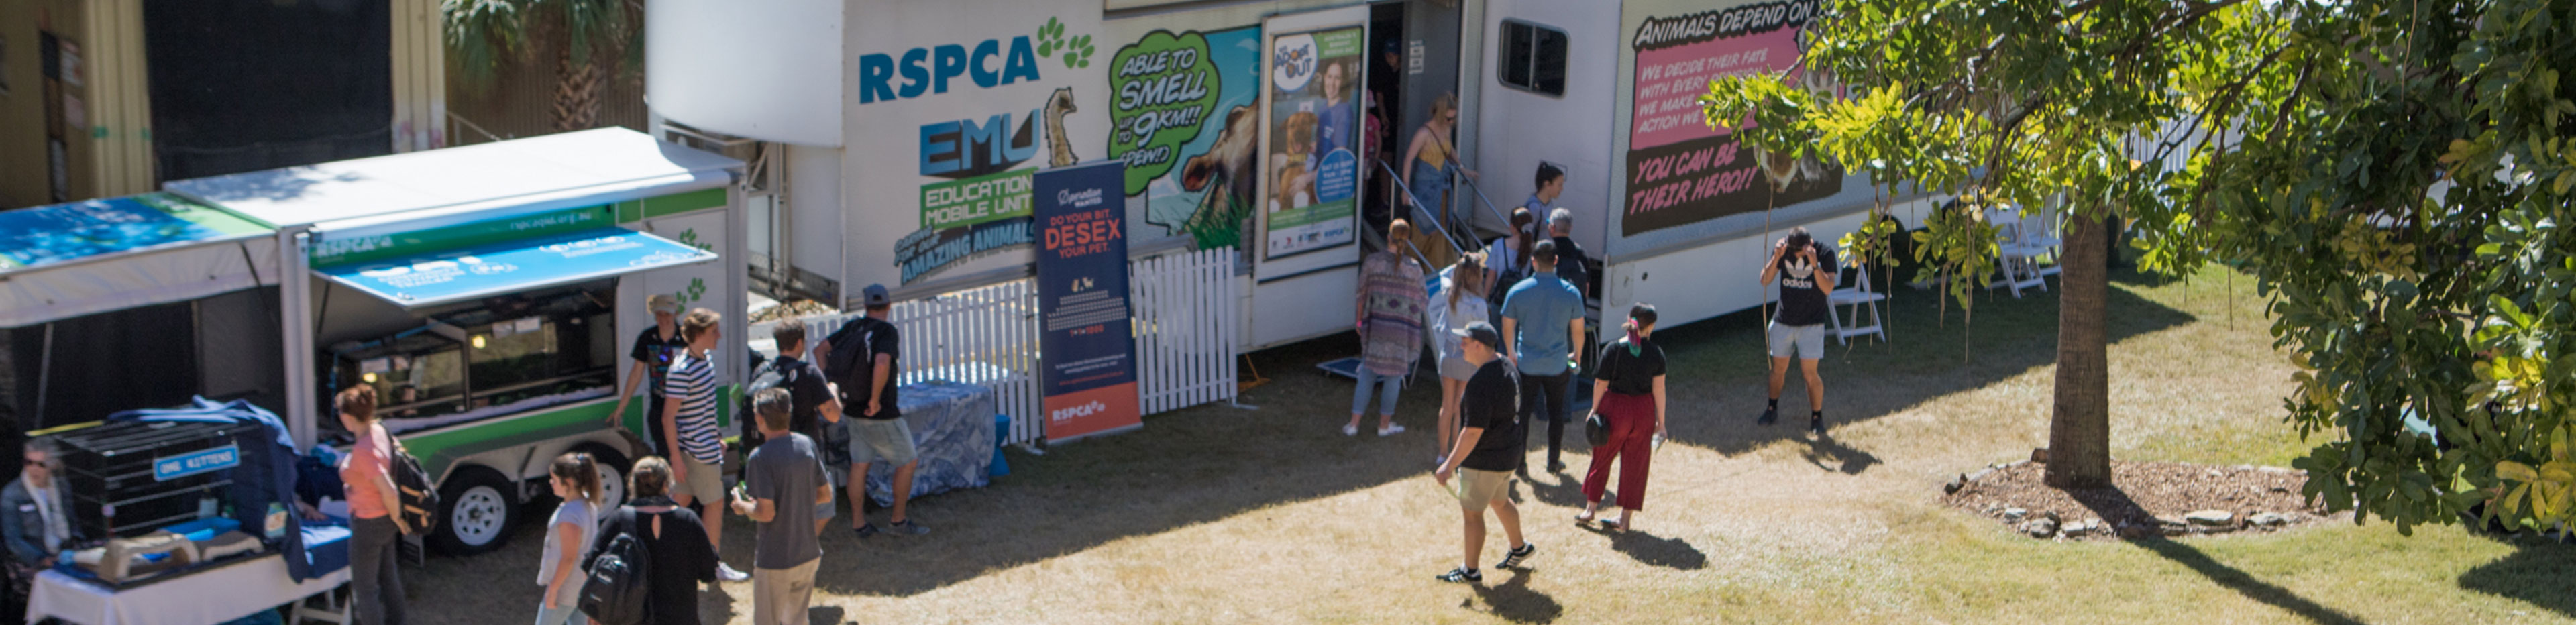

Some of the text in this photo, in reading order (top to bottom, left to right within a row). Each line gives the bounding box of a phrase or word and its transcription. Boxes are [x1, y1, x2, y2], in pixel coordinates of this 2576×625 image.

[1635, 14, 1717, 46] ANIMALS
[1719, 4, 1786, 32] DEPEND
[1788, 1, 1813, 22] ON
[859, 36, 1041, 105] RSPCA
[1119, 48, 1197, 78] ABLE TO
[1274, 44, 1309, 70] ADOPT
[1286, 58, 1312, 78] OUT
[1641, 48, 1769, 81] WE DECIDE THEIR FATE
[1118, 70, 1207, 110] SMELL
[1640, 82, 1667, 100] WITH
[1672, 75, 1708, 95] EVERY
[1638, 114, 1678, 133] ACTION
[1682, 109, 1700, 125] WE
[1639, 95, 1695, 117] WE MAKE
[920, 108, 1041, 178] EMU
[1118, 117, 1135, 143] UP TO
[1635, 139, 1740, 185] YOU CAN BE
[926, 174, 1033, 207] EDUCATION
[1630, 166, 1758, 215] THEIR HERO!!
[926, 194, 1032, 225] MOBILE UNIT
[1049, 209, 1113, 227] DO YOUR BIT.
[1044, 218, 1122, 251] DESEX
[902, 233, 971, 284] AMAZING
[1059, 242, 1111, 258] YOUR PET.
[1783, 278, 1813, 289] adidas
[1052, 404, 1093, 421] RSPCA
